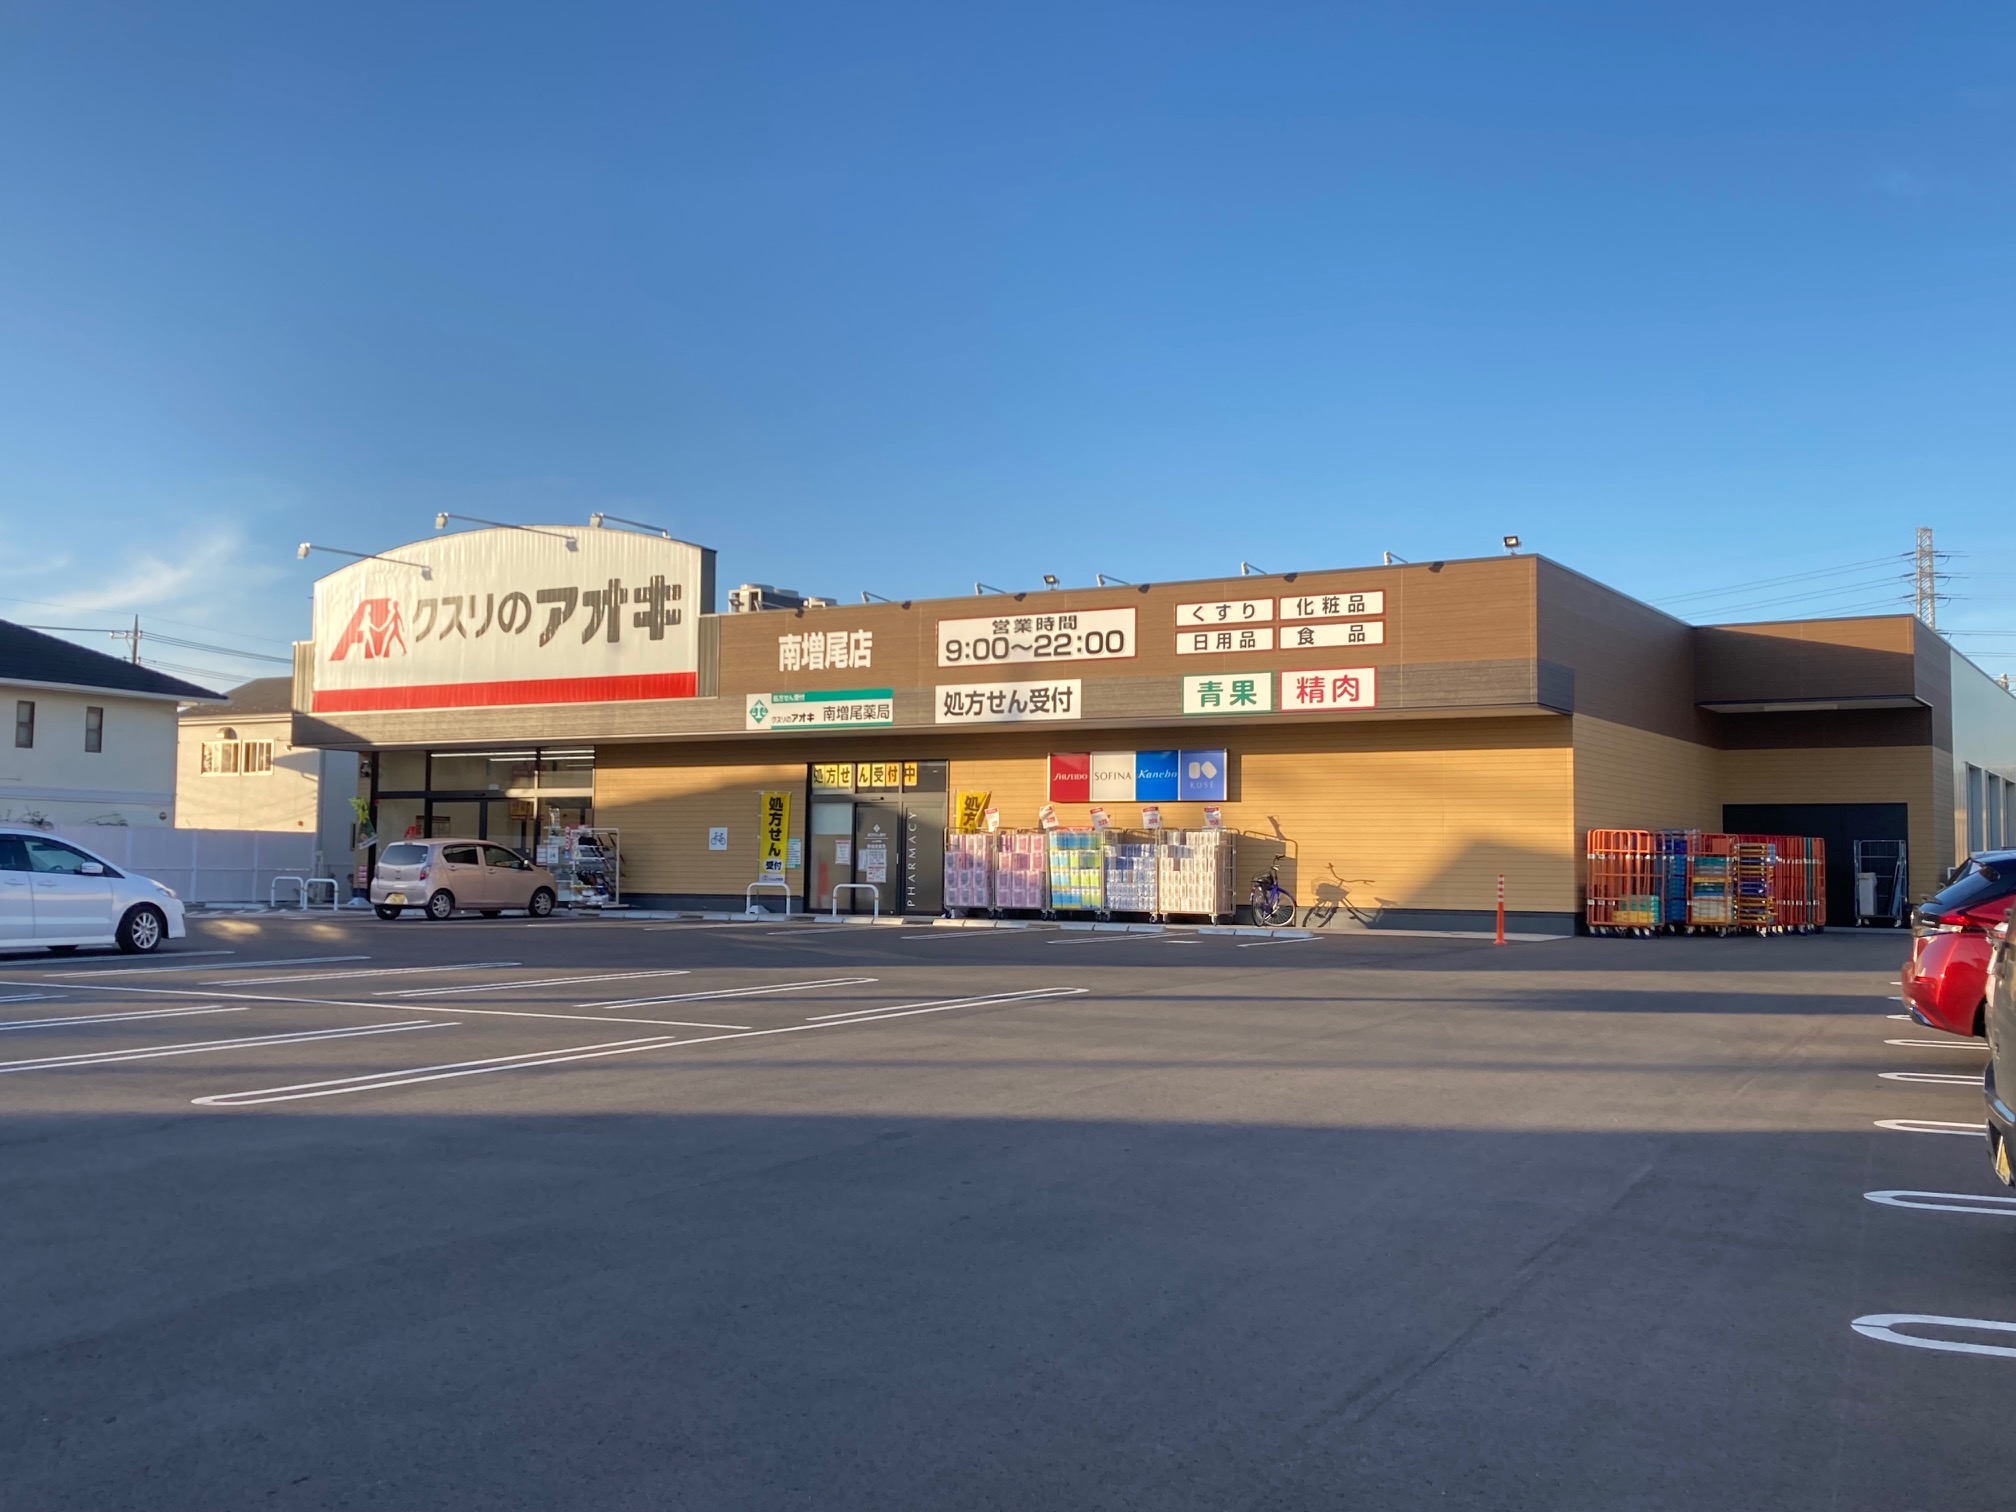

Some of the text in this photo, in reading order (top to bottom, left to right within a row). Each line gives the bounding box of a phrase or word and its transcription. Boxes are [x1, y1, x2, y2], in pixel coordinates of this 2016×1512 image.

[412, 574, 682, 648] クスリのアオキ
[1192, 602, 1256, 622] くすり
[1296, 594, 1365, 617] 化粧品
[992, 615, 1078, 635] 営業時間
[778, 629, 873, 672] 南増尾店
[1193, 630, 1256, 651] 日用品
[1197, 679, 1257, 708] 青果
[1296, 674, 1360, 705] 精肉
[823, 703, 890, 722] 南増尾薬局
[943, 686, 1073, 717] 処方せん受付
[813, 766, 916, 785] 処方せん受付中
[1053, 772, 1088, 781] SHISEIDO
[1094, 771, 1132, 781] SOFINA
[1138, 768, 1178, 780] Kanebo
[962, 795, 980, 833] 処方
[768, 796, 784, 857] 処方せん
[765, 860, 782, 871] 受付
[906, 811, 918, 908] PHARMACY
